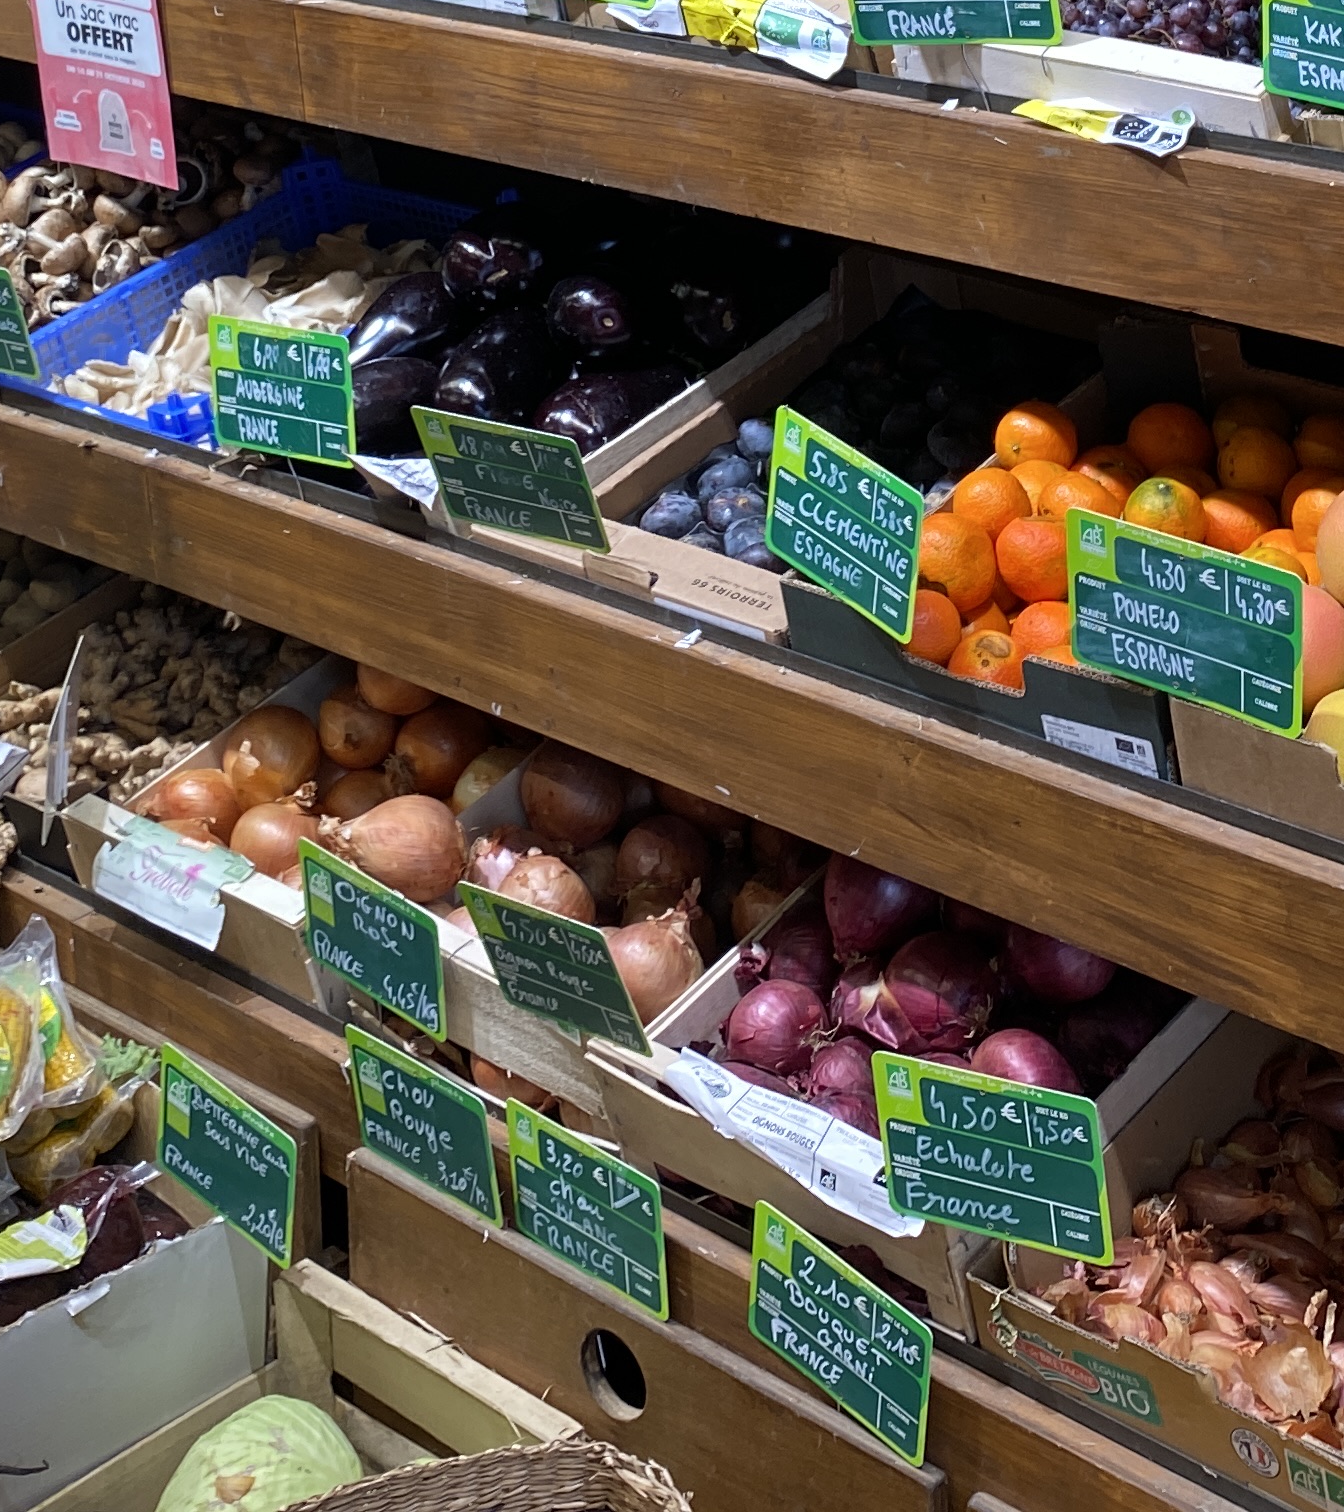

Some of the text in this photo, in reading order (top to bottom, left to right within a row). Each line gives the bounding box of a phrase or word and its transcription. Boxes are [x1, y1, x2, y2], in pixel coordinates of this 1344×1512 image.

[66, 22, 134, 54] OFFERT
[80, 4, 106, 25] Sac
[108, 10, 139, 32] vrac
[887, 9, 956, 38] FRANCE
[235, 374, 306, 410] AUBERGINE
[238, 418, 280, 444] FRANCE
[463, 496, 532, 527] FRANCE
[798, 492, 909, 580] CLEMENTINE
[793, 532, 863, 588] ESPAGNE
[1141, 548, 1186, 593] 4,30
[709, 585, 772, 611] TERROIRS
[1112, 591, 1180, 635] POMELO
[1111, 633, 1196, 683] ESPAGNE
[335, 880, 416, 942] OIGNON
[929, 1084, 997, 1132] 4,50
[364, 1116, 422, 1165] FRANCE
[915, 1134, 1036, 1185] Echalote
[164, 1143, 214, 1191] FRANCE
[904, 1181, 1020, 1226] France
[532, 1211, 615, 1277] FRANCE
[554, 1199, 625, 1255] BLANC
[784, 1277, 893, 1368] BOUQUET
[770, 1316, 843, 1387] FRANCE
[1087, 1360, 1140, 1388] LÉGUMES
[1099, 1376, 1150, 1416] BIO
